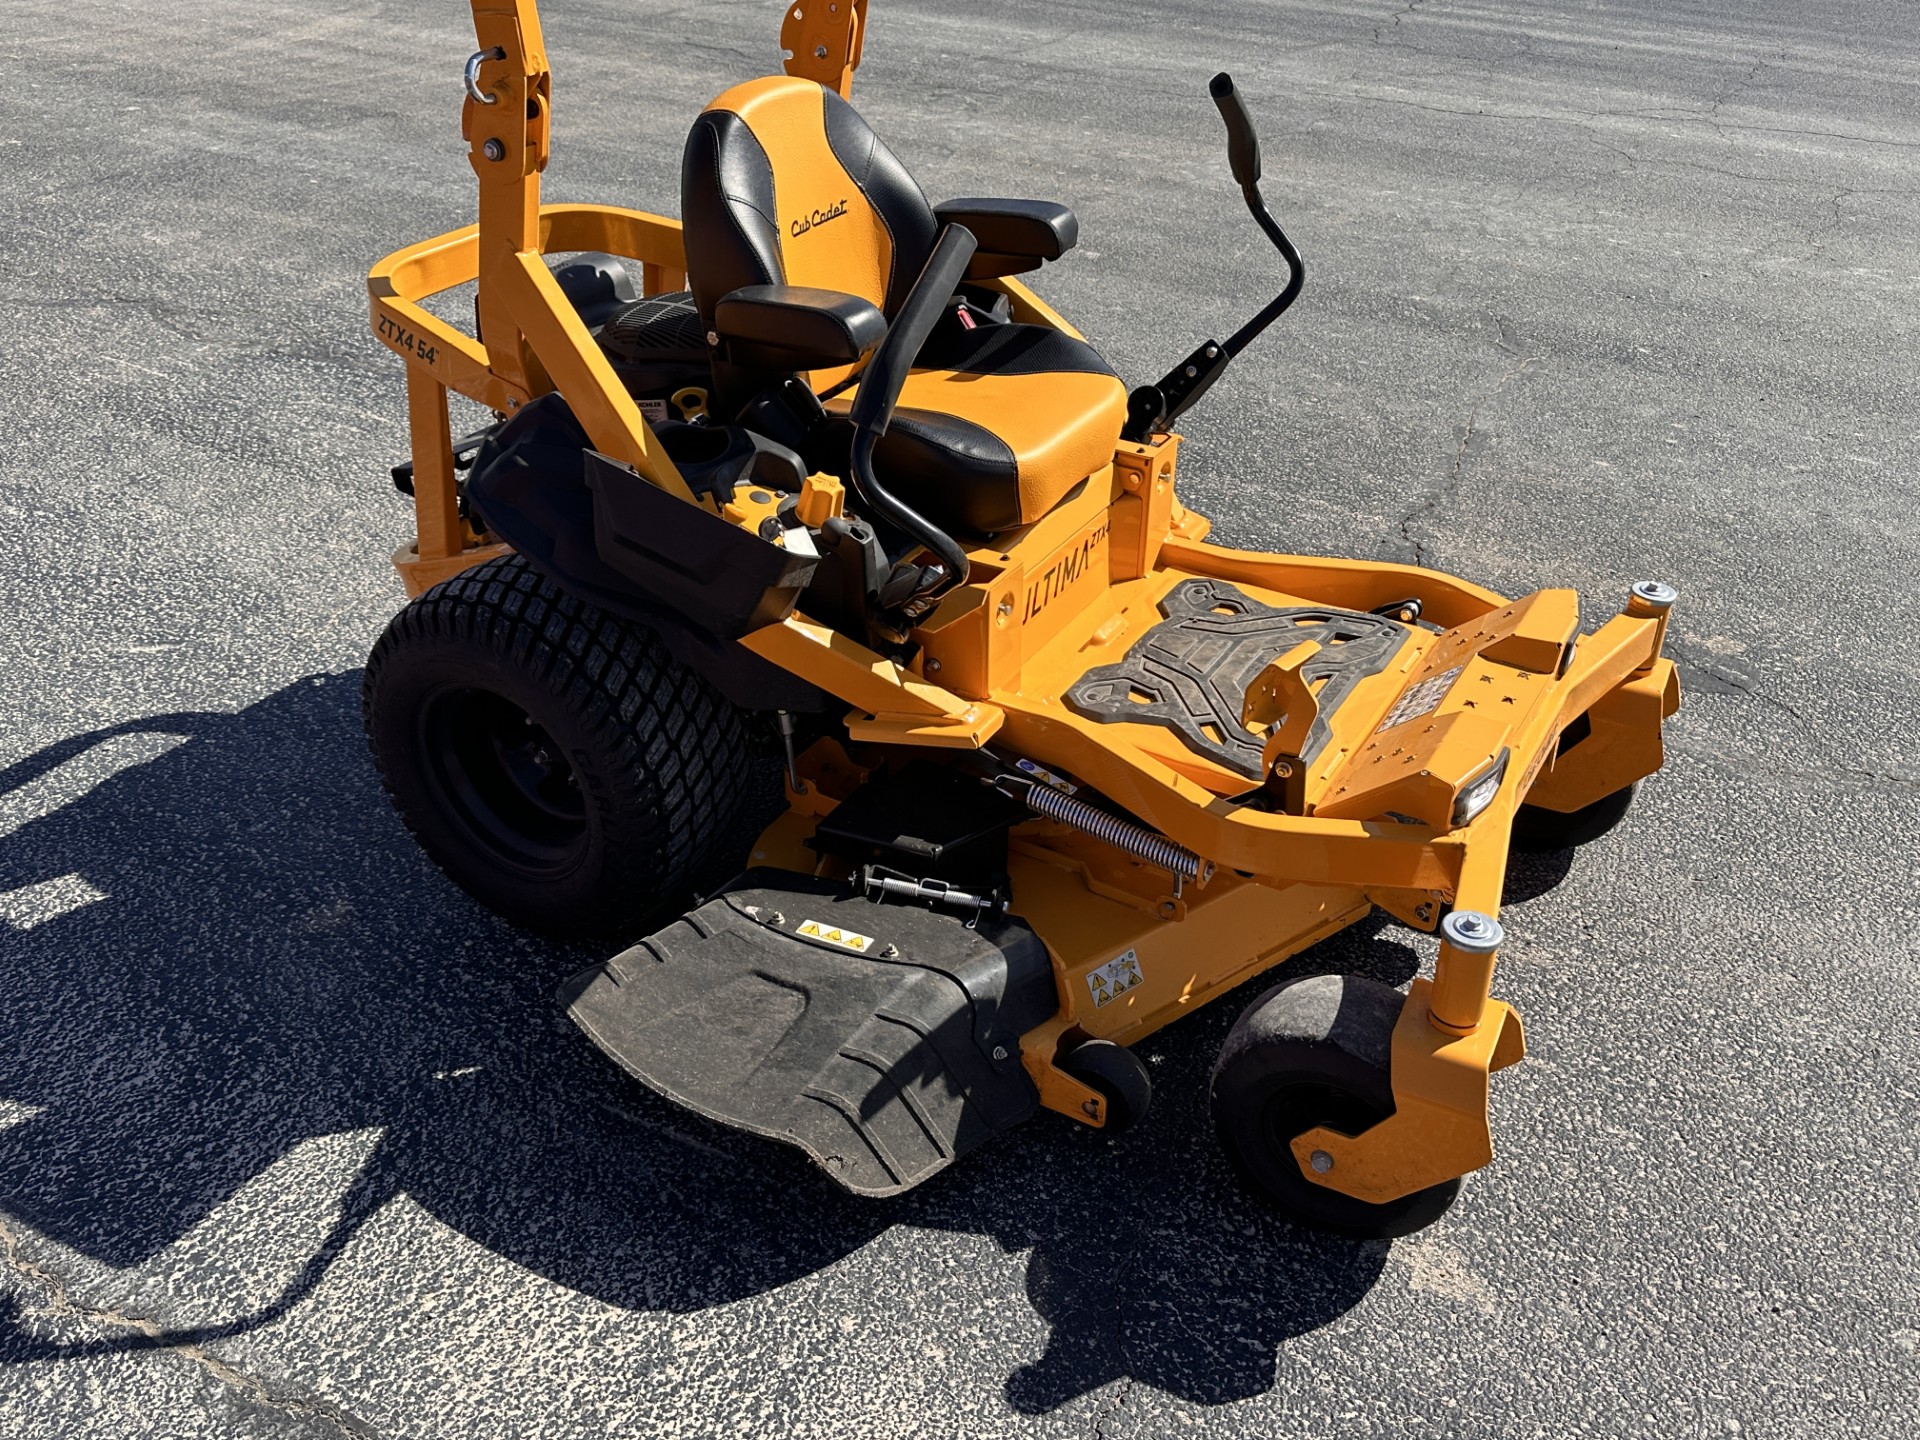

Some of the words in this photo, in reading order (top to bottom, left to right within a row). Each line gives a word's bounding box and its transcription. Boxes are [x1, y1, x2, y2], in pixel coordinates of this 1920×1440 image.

[791, 215, 811, 238] Cub
[811, 199, 848, 227] Cadet
[378, 313, 414, 352] ZTX4
[417, 338, 440, 366] 54"
